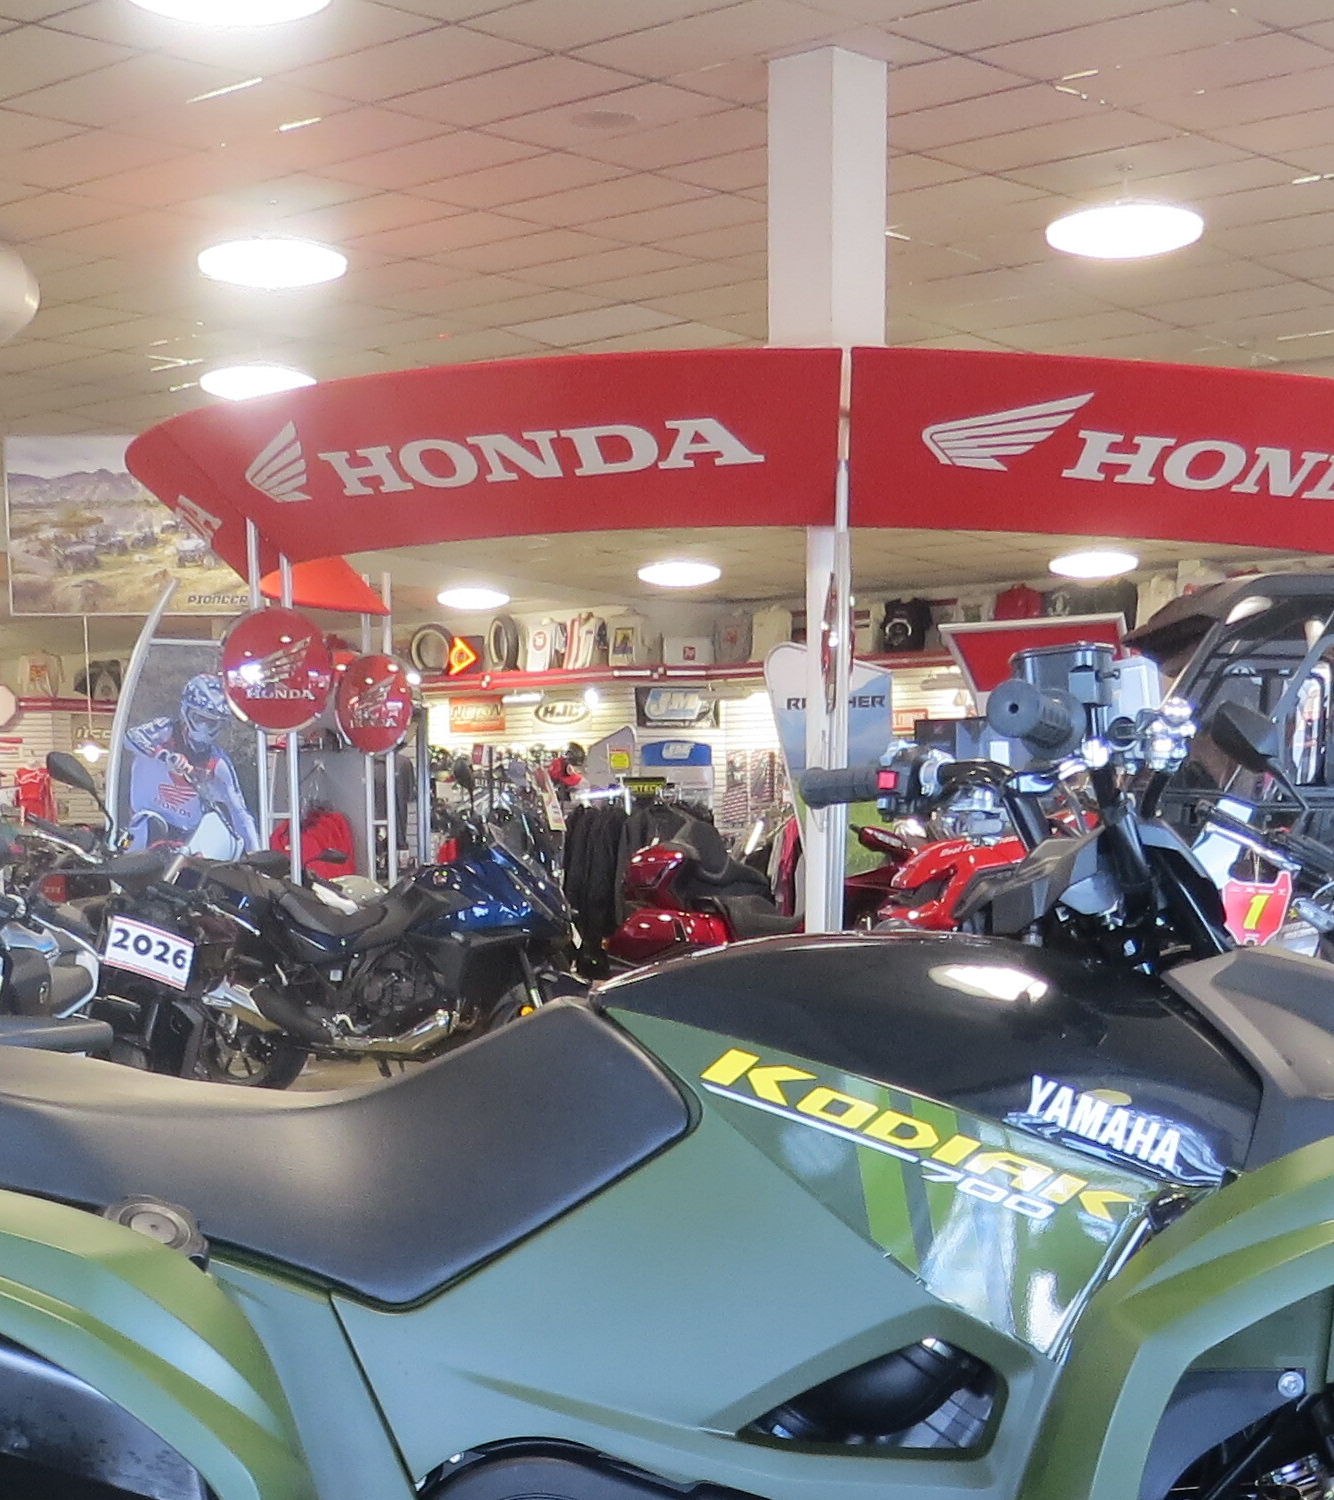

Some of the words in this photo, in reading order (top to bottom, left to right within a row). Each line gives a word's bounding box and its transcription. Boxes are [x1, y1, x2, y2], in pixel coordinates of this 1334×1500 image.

[318, 418, 765, 498] HONDA
[246, 688, 316, 700] HONDA
[1242, 894, 1272, 930] 1
[112, 927, 188, 971] 2026
[700, 1048, 1138, 1222] KODIAK
[1025, 1074, 1181, 1172] YAMAHA
[919, 1160, 1056, 1220] 700
